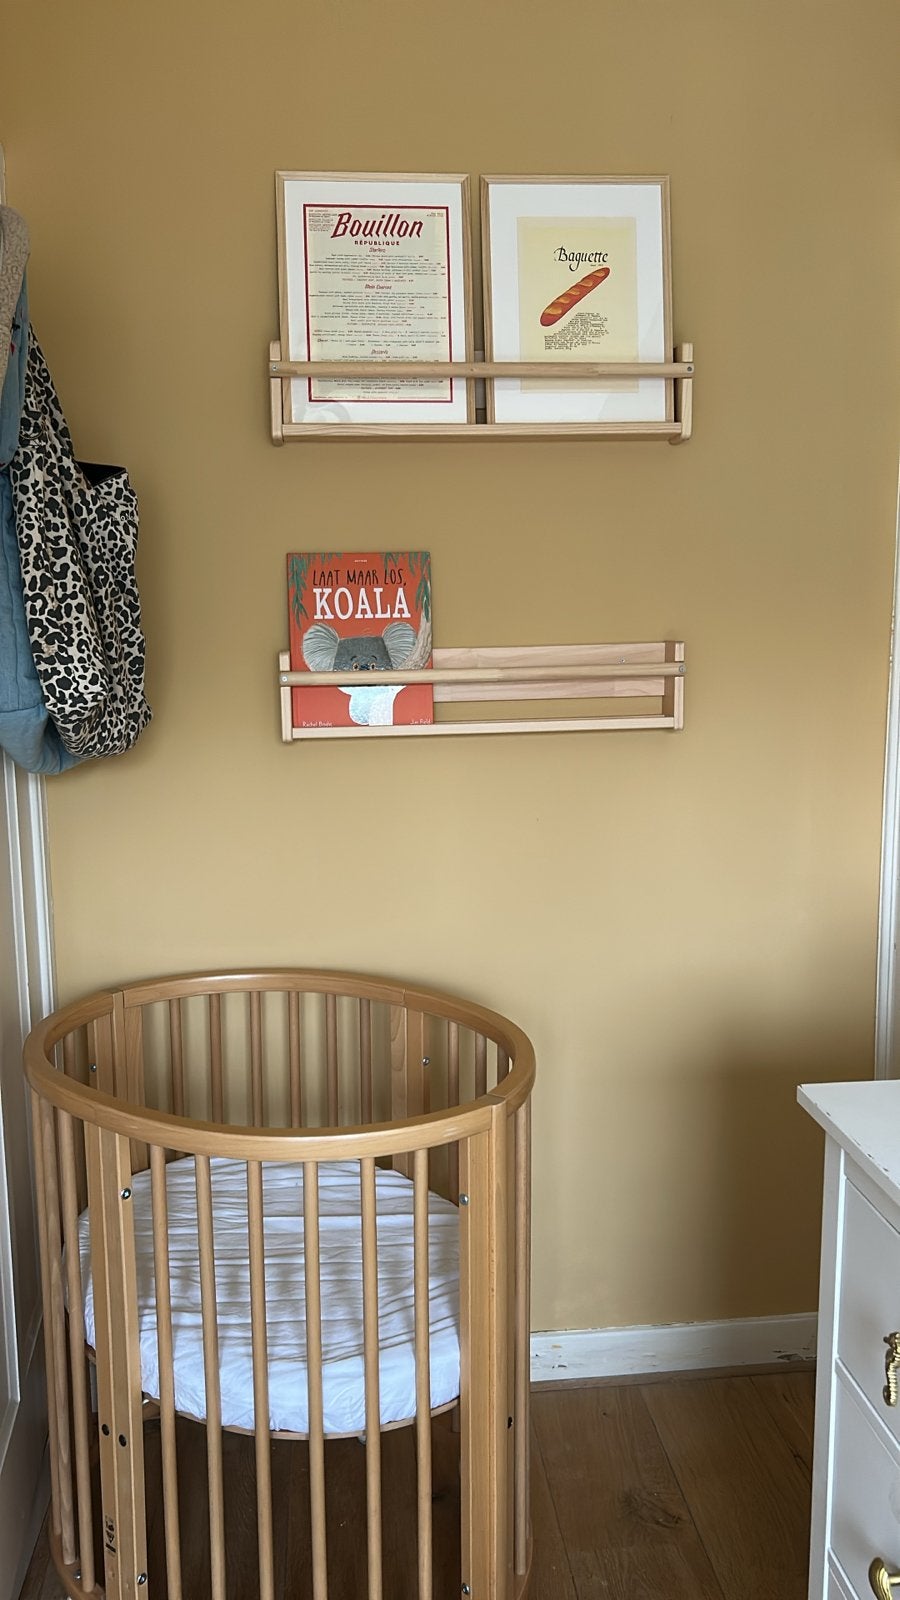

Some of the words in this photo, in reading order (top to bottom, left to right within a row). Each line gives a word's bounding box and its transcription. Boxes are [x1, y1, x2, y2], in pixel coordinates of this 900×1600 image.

[330, 212, 424, 239] Bouillon
[553, 246, 609, 272] Baguette
[312, 569, 341, 586] LAAT
[346, 569, 379, 586] MAAR
[383, 568, 407, 586] LOS,
[312, 587, 411, 620] KOALA
